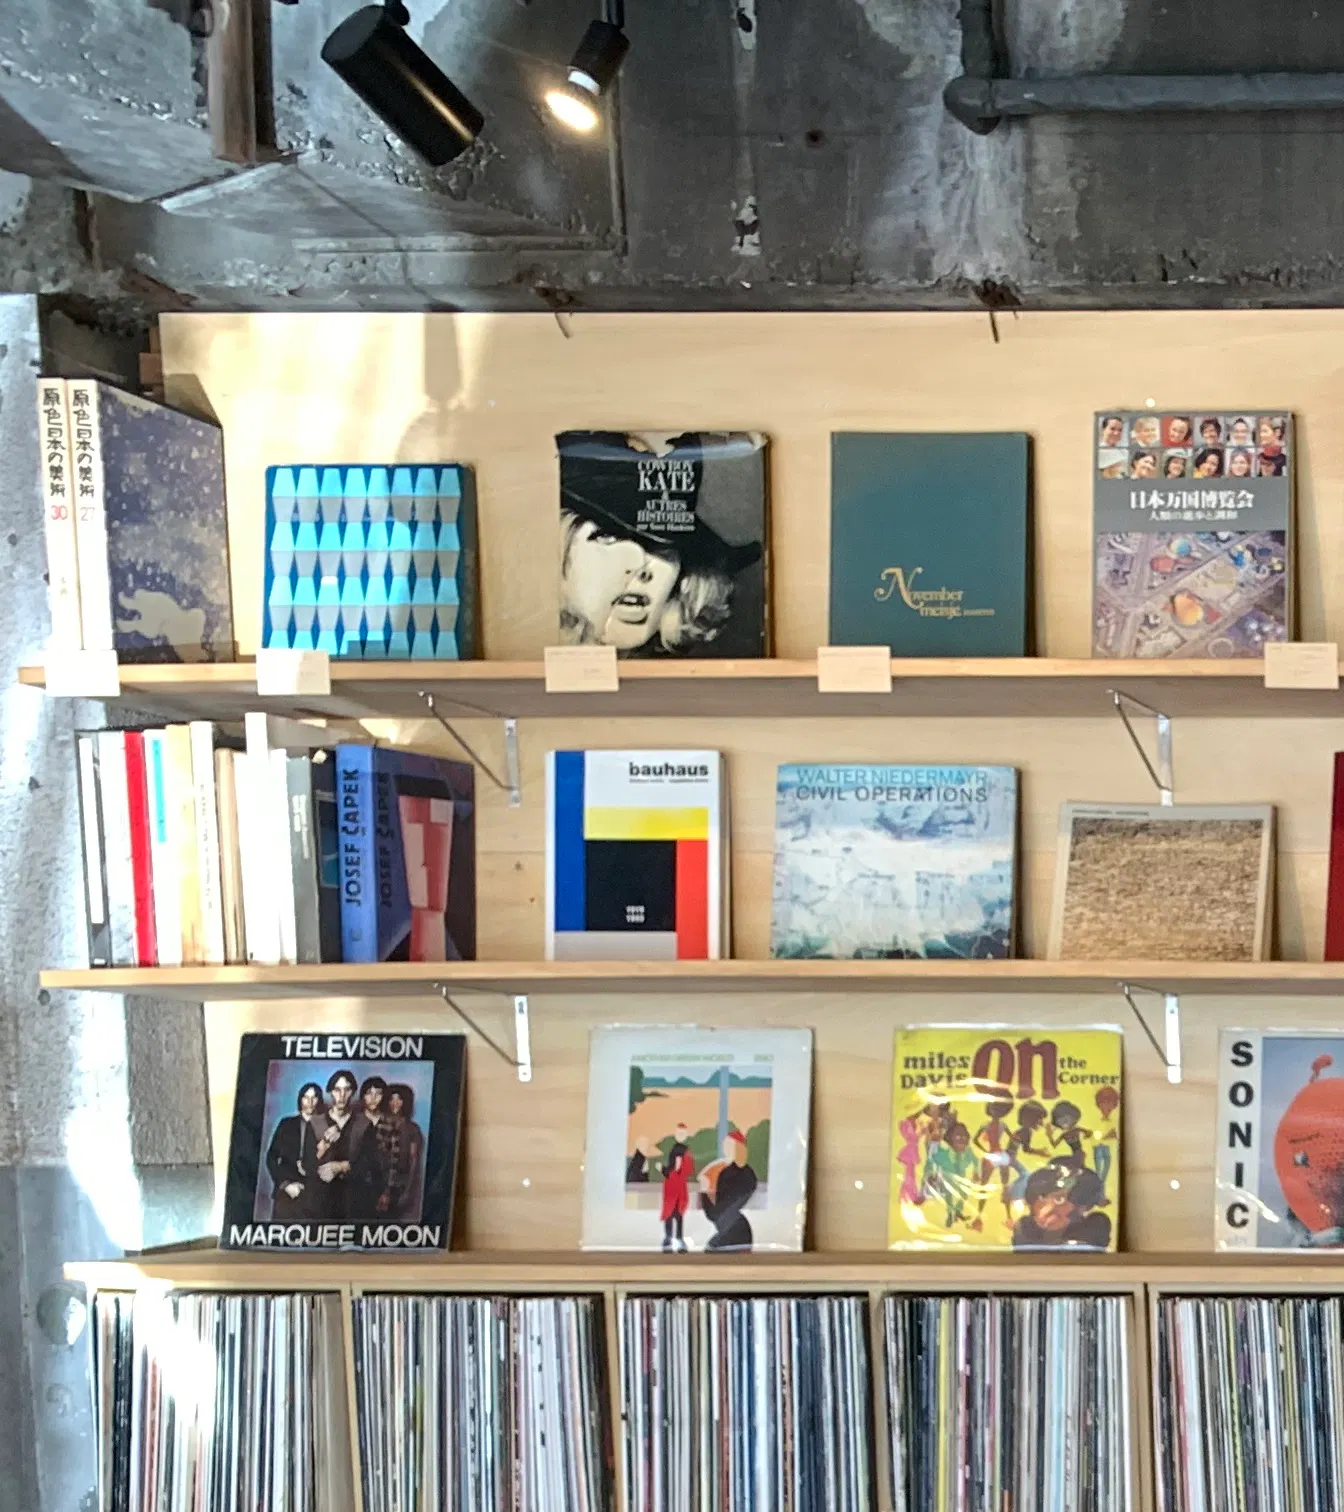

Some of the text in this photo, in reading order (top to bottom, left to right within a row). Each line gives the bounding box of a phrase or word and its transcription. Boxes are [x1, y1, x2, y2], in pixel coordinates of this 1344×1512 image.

[42, 387, 66, 498] 原色日本の美術
[72, 388, 95, 499] 原色日本の美術
[638, 471, 695, 491] KATE
[1129, 489, 1255, 509] 日本万国博覧会
[873, 566, 965, 610] November
[628, 762, 709, 777] bauhaus
[796, 768, 988, 786] WALTER NIEDERMAYR
[795, 785, 988, 803] CIVIL OPERATIONS
[344, 842, 362, 907] JOSEF
[378, 846, 393, 908] JOSEF
[280, 1036, 424, 1059] TELEVISION
[903, 1051, 972, 1070] miles
[1059, 1056, 1087, 1069] the
[1057, 1071, 1121, 1086] Corner
[1226, 1041, 1256, 1229] SONIC
[229, 1224, 441, 1247] MARQUEE MOON
